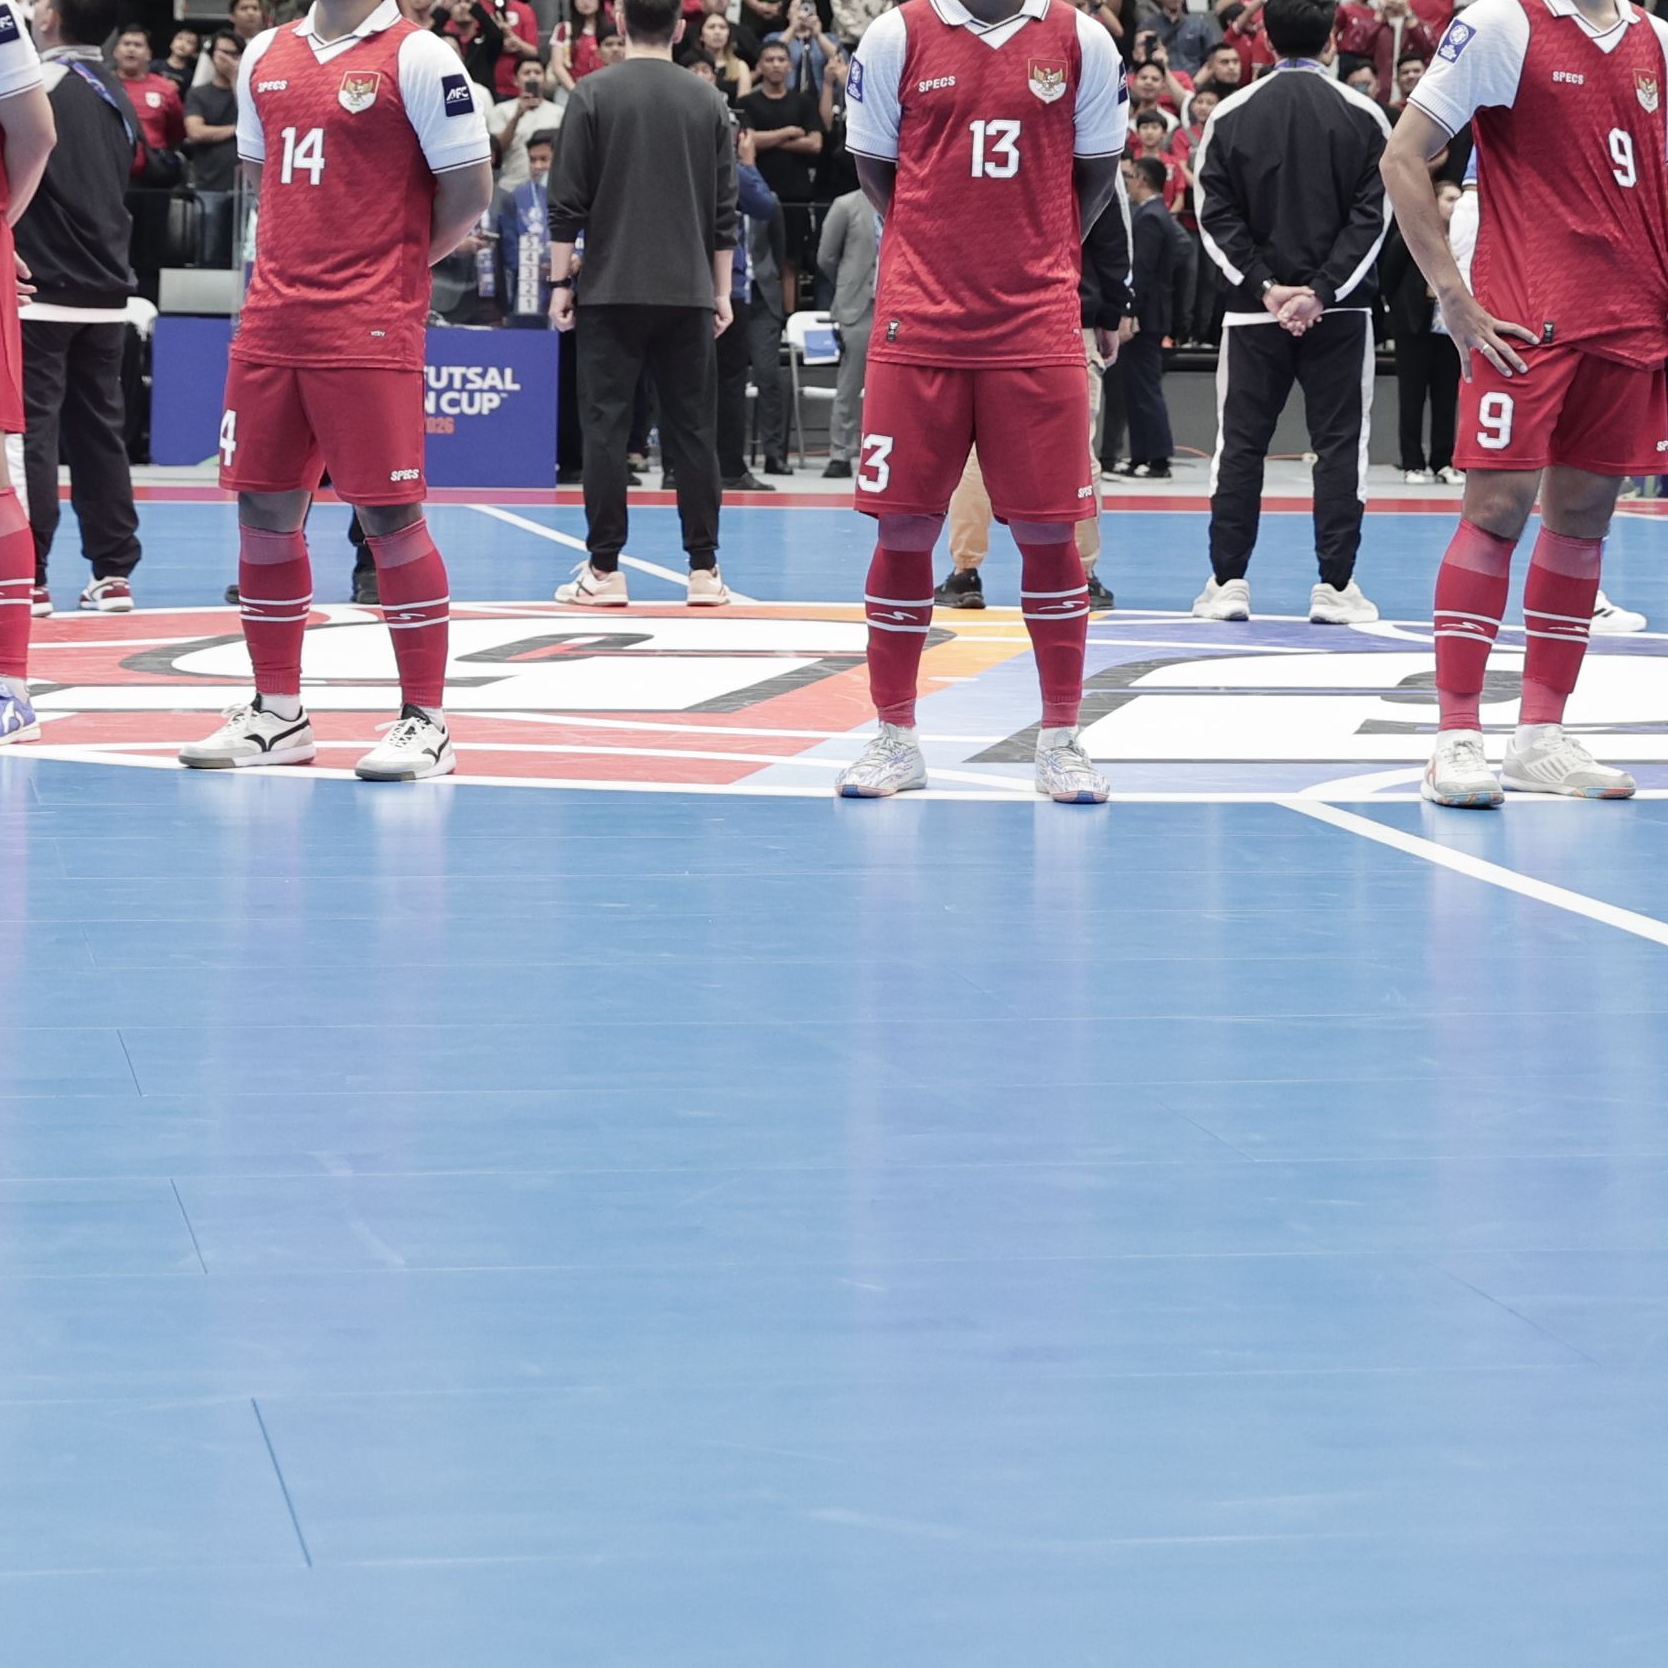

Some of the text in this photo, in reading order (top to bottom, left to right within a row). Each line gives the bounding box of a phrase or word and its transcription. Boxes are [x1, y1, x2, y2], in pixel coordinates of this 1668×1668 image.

[446, 85, 470, 101] AFC
[918, 75, 956, 92] SPECS
[1552, 71, 1584, 85] SPECS
[281, 126, 325, 185] 14
[969, 119, 1021, 178] 13
[1608, 127, 1637, 188] 9
[1477, 391, 1514, 450] 9
[391, 469, 419, 482] SPECS
